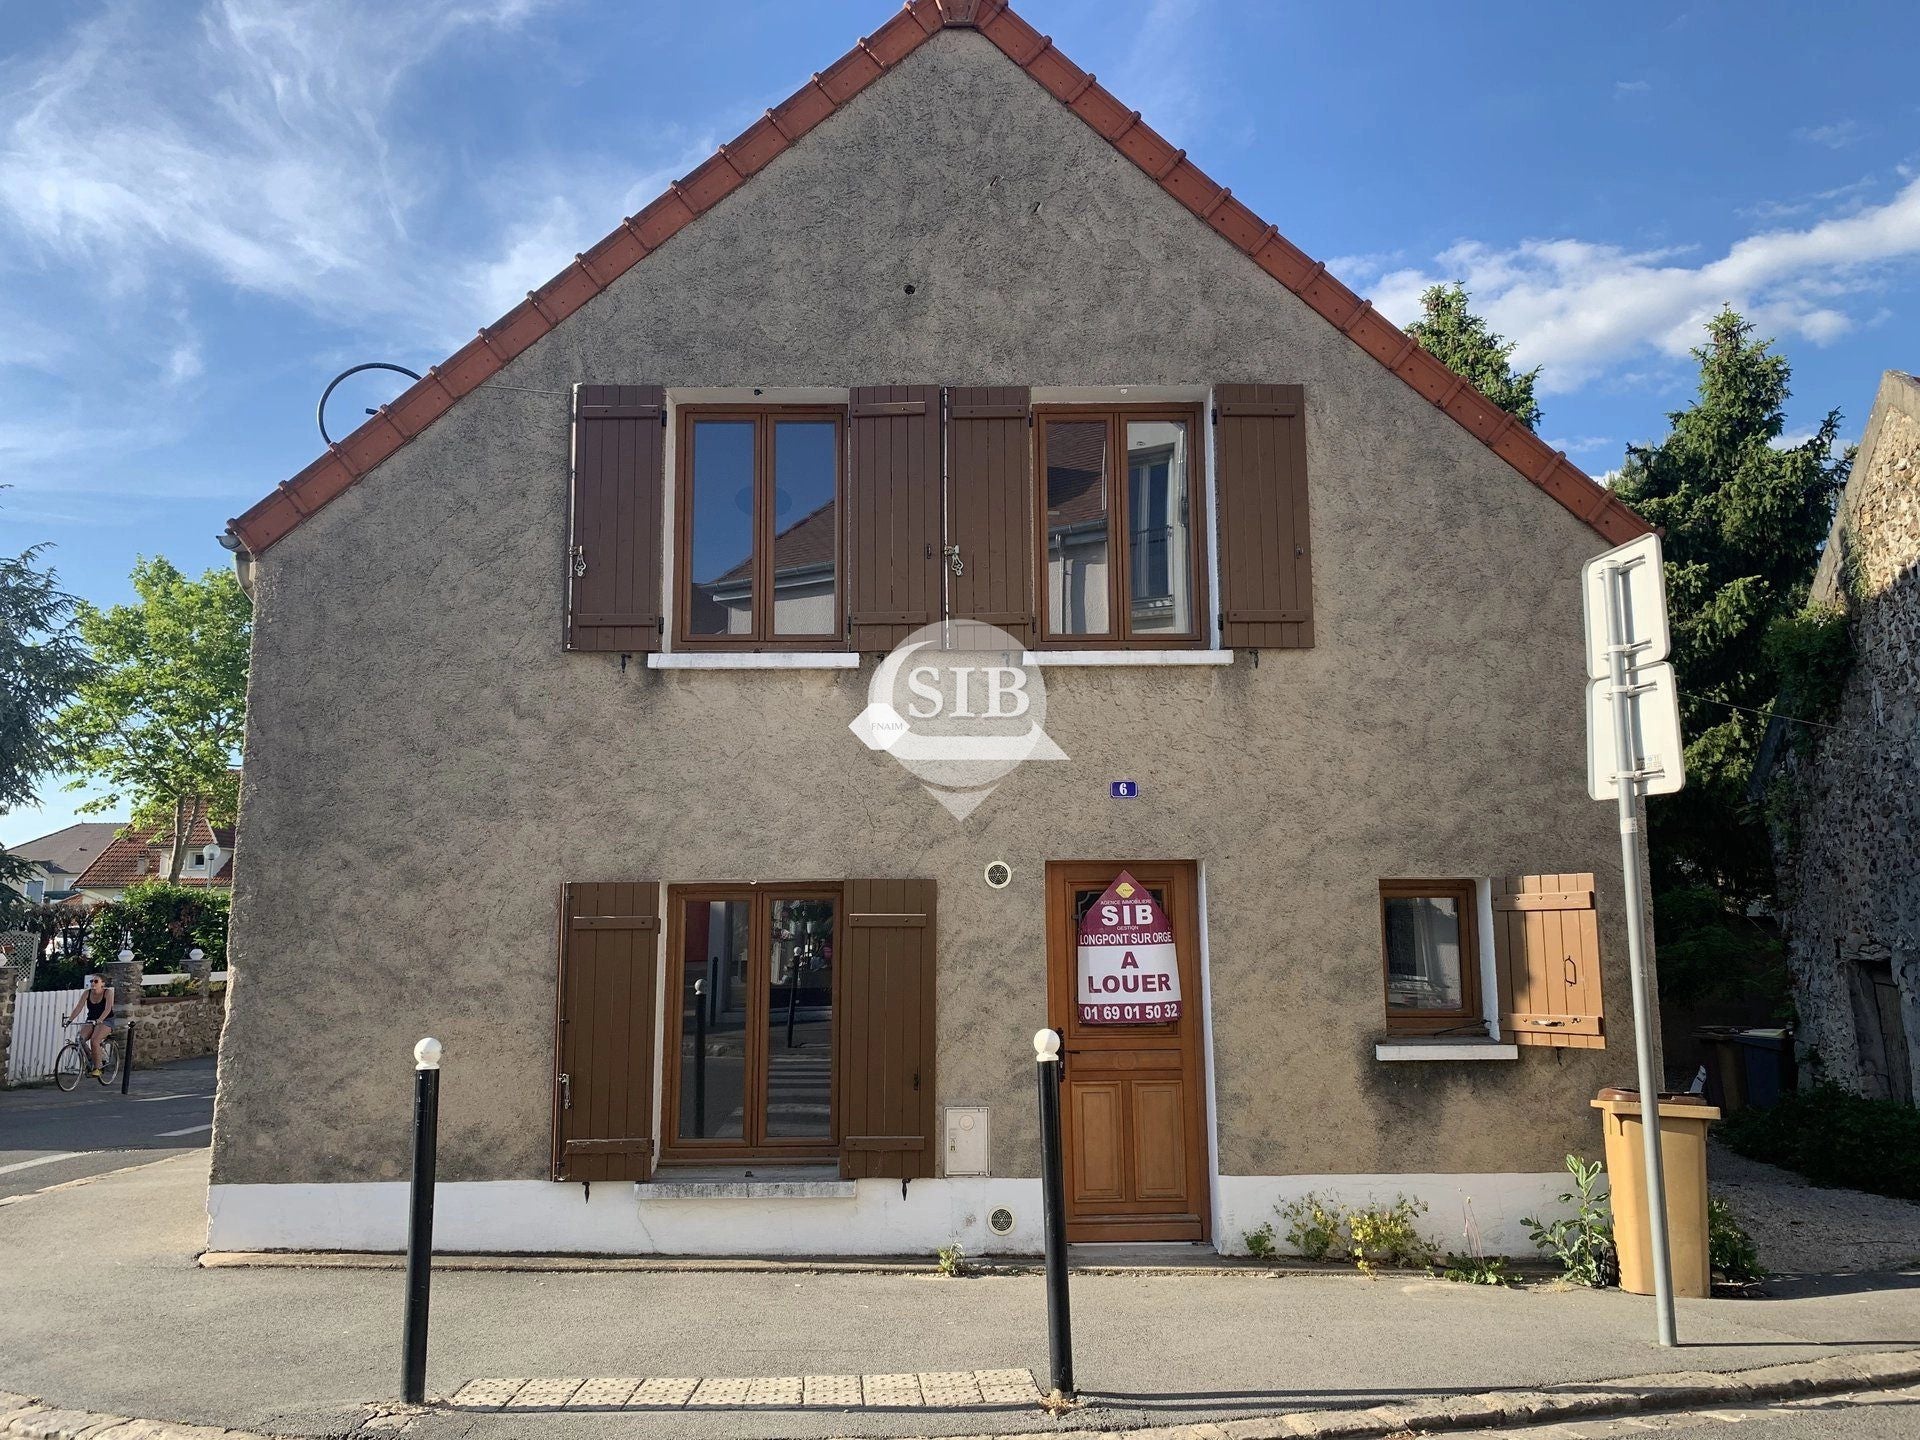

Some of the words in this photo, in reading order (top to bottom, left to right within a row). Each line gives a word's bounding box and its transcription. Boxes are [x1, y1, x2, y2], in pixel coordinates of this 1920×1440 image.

[1119, 782, 1128, 796] 6
[1101, 904, 1154, 926] SIB
[1080, 933, 1129, 945] LONGPONT
[1130, 933, 1152, 944] SUR
[1152, 931, 1172, 943] ORGE
[1120, 951, 1139, 969] A
[1087, 973, 1172, 994] LOUER
[1083, 1006, 1098, 1020] 01
[1103, 1005, 1120, 1019] 69
[1124, 1005, 1140, 1019] 01
[1145, 1004, 1161, 1019] 50
[1164, 1003, 1178, 1018] 32
